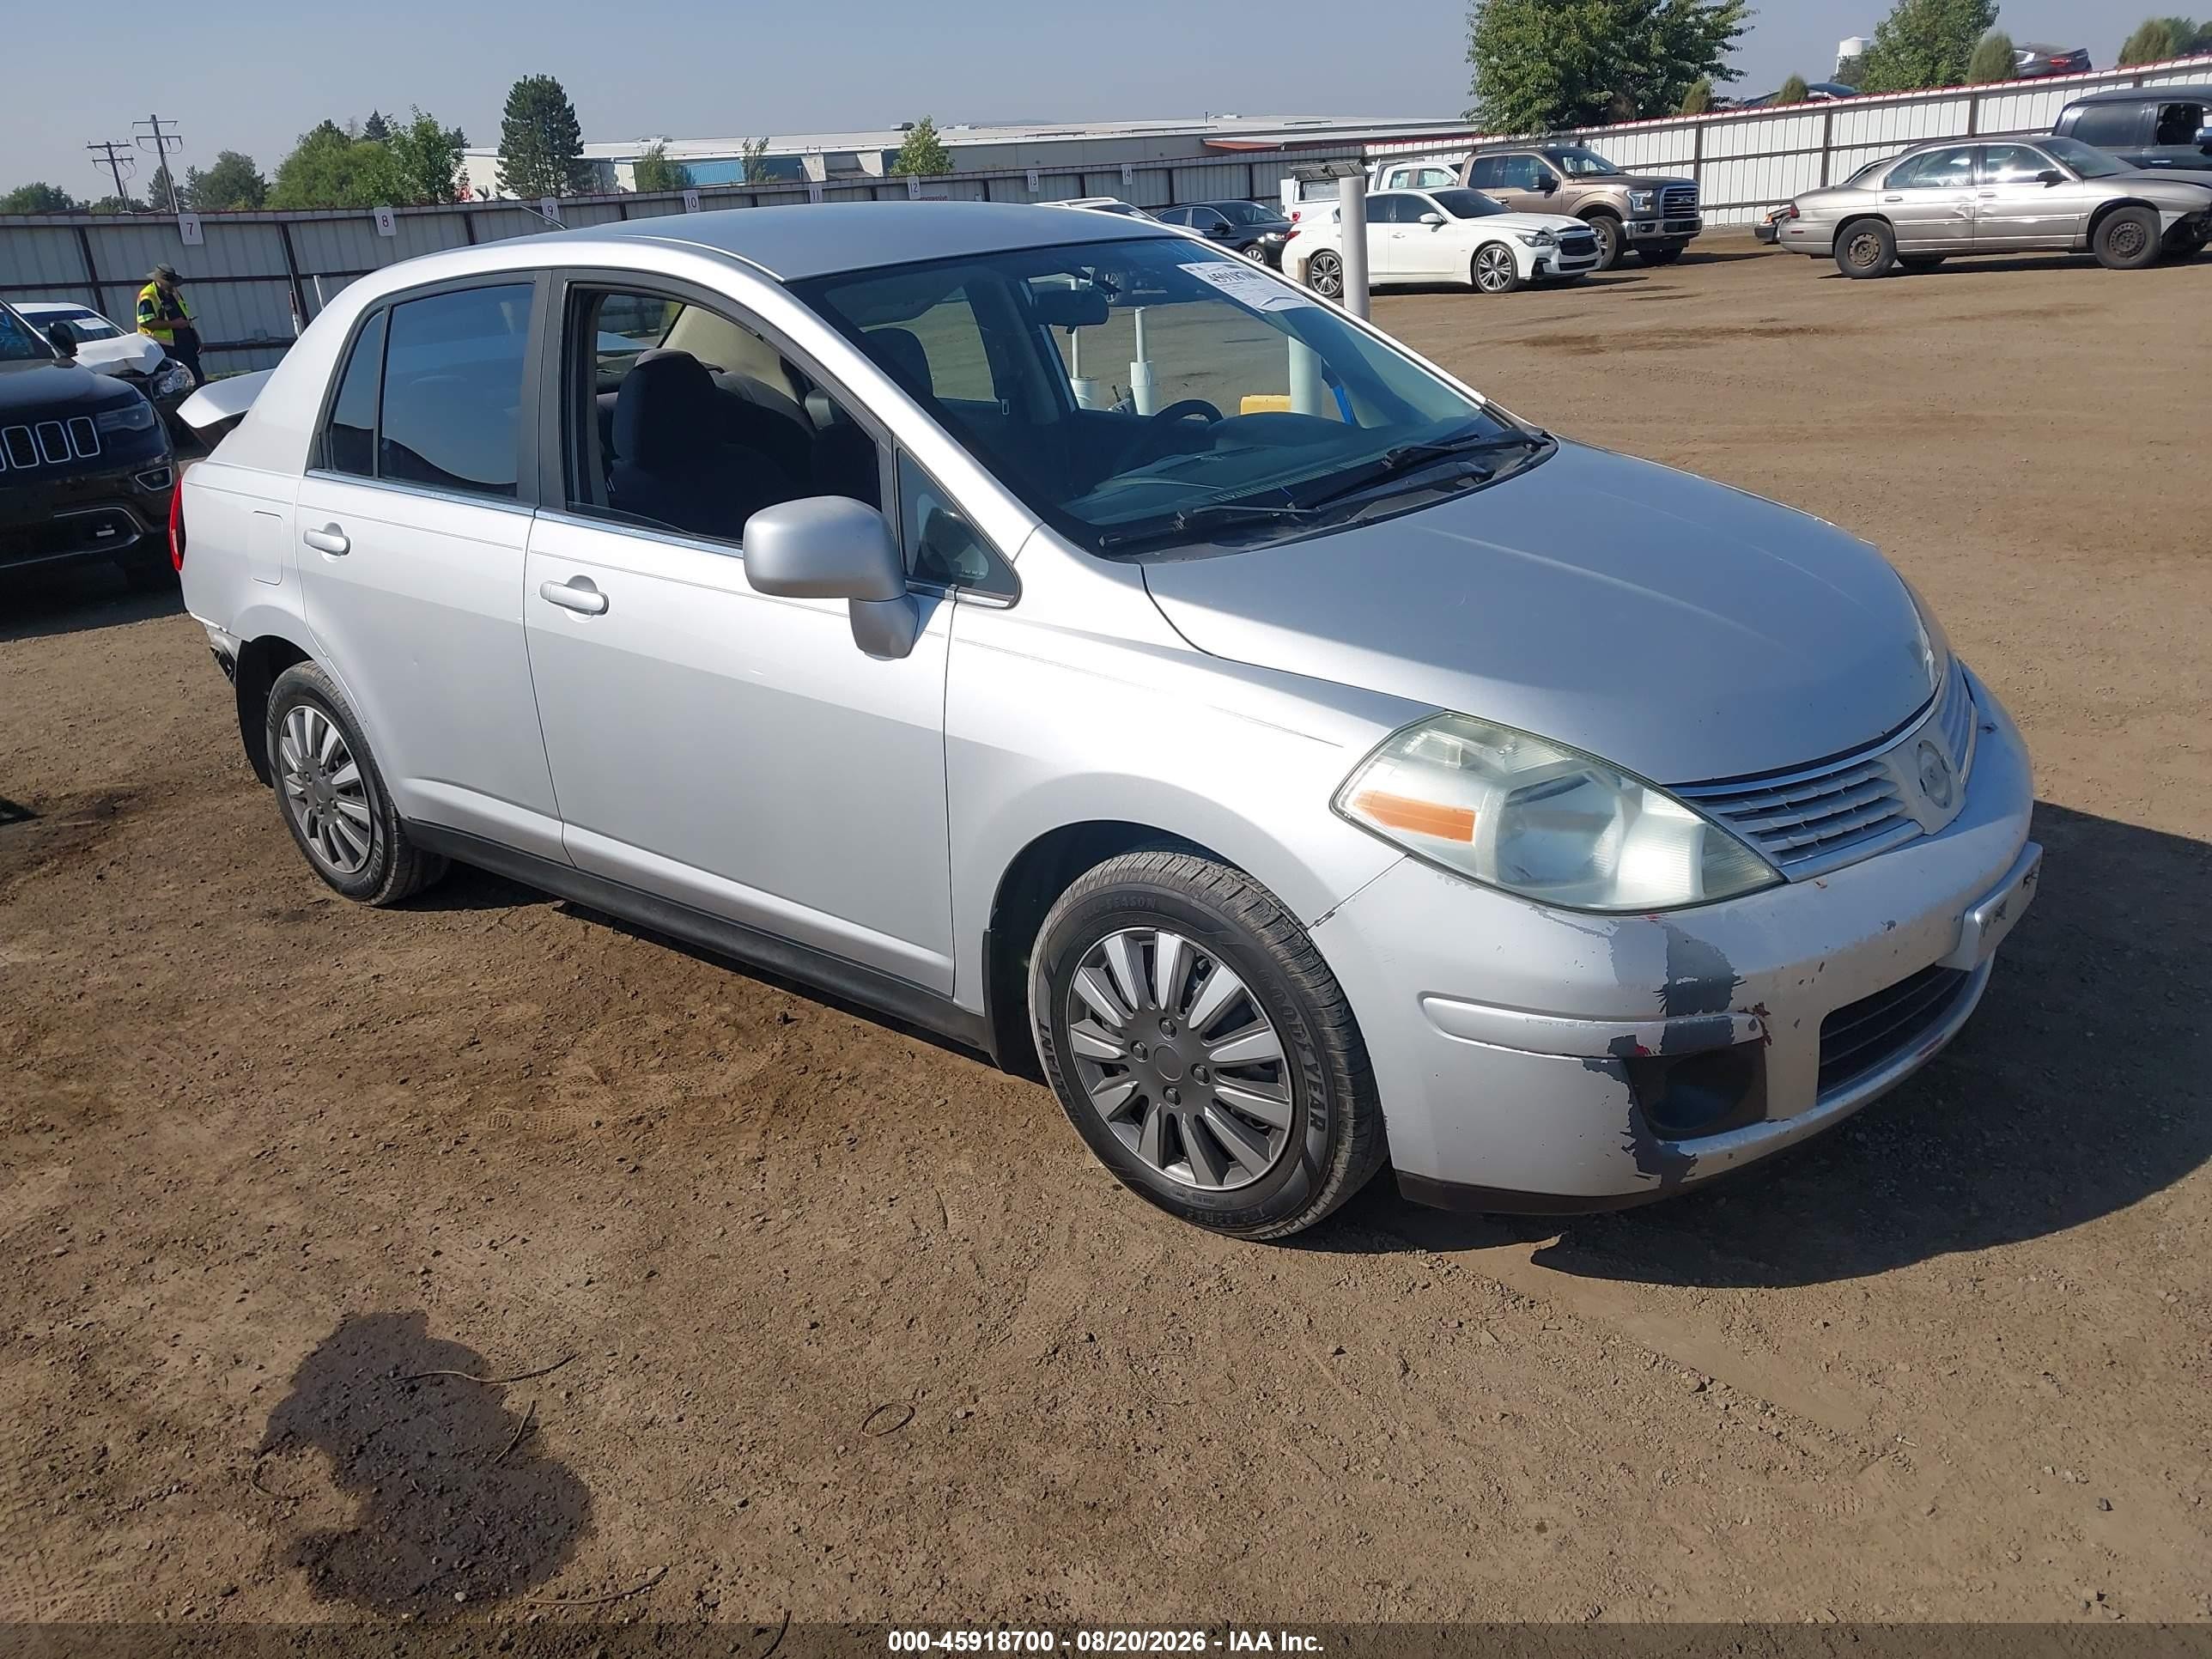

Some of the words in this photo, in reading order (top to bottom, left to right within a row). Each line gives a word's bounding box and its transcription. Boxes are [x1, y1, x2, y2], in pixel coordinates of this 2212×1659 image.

[1030, 175, 1037, 185] 13
[910, 183, 919, 193] 12
[811, 190, 819, 201] 11
[687, 197, 697, 209] 10
[547, 204, 554, 216] 9
[381, 215, 389, 228] 8
[186, 222, 193, 236] 7
[1257, 969, 1327, 1133] GOODYEAR
